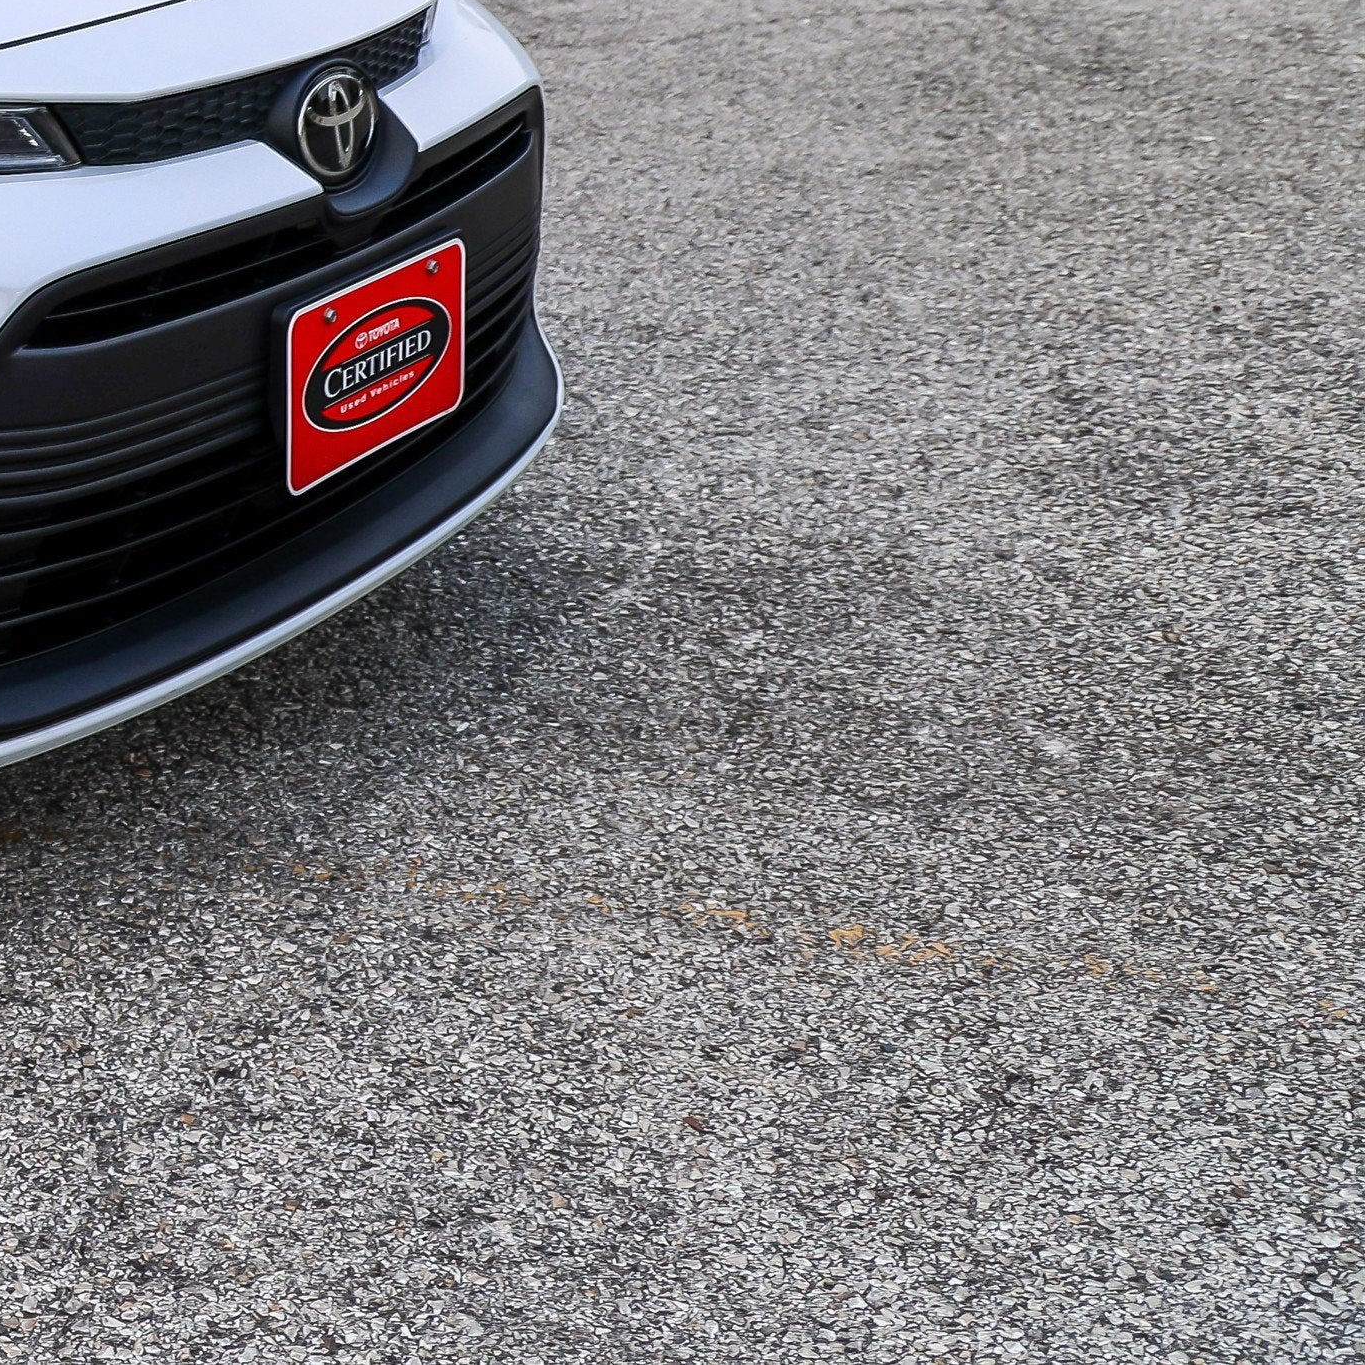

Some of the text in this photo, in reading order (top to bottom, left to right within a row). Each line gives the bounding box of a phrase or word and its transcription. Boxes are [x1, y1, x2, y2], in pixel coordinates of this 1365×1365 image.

[367, 318, 400, 341] TOYOTA
[324, 330, 431, 398] CERTIFIED
[340, 371, 415, 413] Used Vehicles
